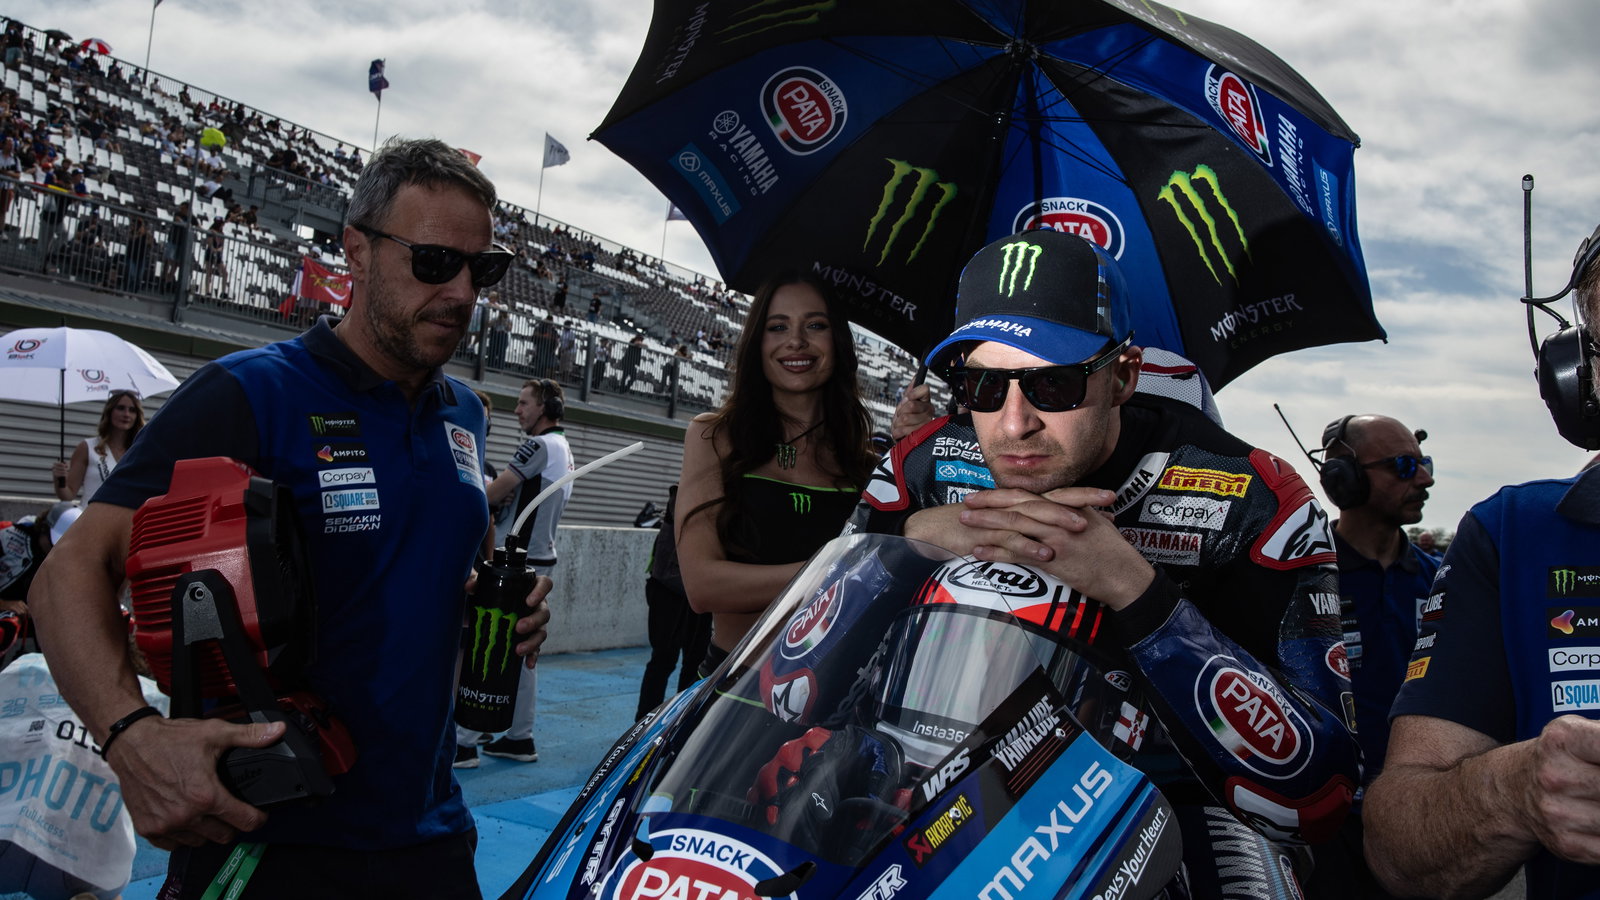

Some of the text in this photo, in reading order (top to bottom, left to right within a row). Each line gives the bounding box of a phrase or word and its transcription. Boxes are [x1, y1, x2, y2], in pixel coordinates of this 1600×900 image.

[783, 85, 826, 137] PATA
[819, 80, 844, 114] SNACK
[708, 131, 757, 196] RACING
[728, 124, 779, 195] YAMAHA
[698, 170, 733, 217] MAXUS
[1041, 200, 1086, 213] SNACK
[812, 261, 918, 321] MONSTER
[1210, 293, 1303, 342] MONSTER
[333, 450, 367, 458] AMPITO
[322, 471, 367, 483] Corpay
[1161, 469, 1247, 494] PIRELLI
[333, 492, 365, 509] SQUARE
[1148, 501, 1217, 524] Corpay
[325, 514, 381, 526] SEMAKIN
[340, 522, 380, 533] DEPAN
[1140, 531, 1200, 552] YAMAHA
[951, 562, 1038, 590] Arai
[1221, 676, 1286, 753] PATA
[922, 747, 971, 802] WRS
[20, 806, 37, 823] Full
[925, 794, 973, 849] AKRAPVIČ
[977, 760, 1114, 900] MAXUS
[673, 835, 751, 871] SNACK
